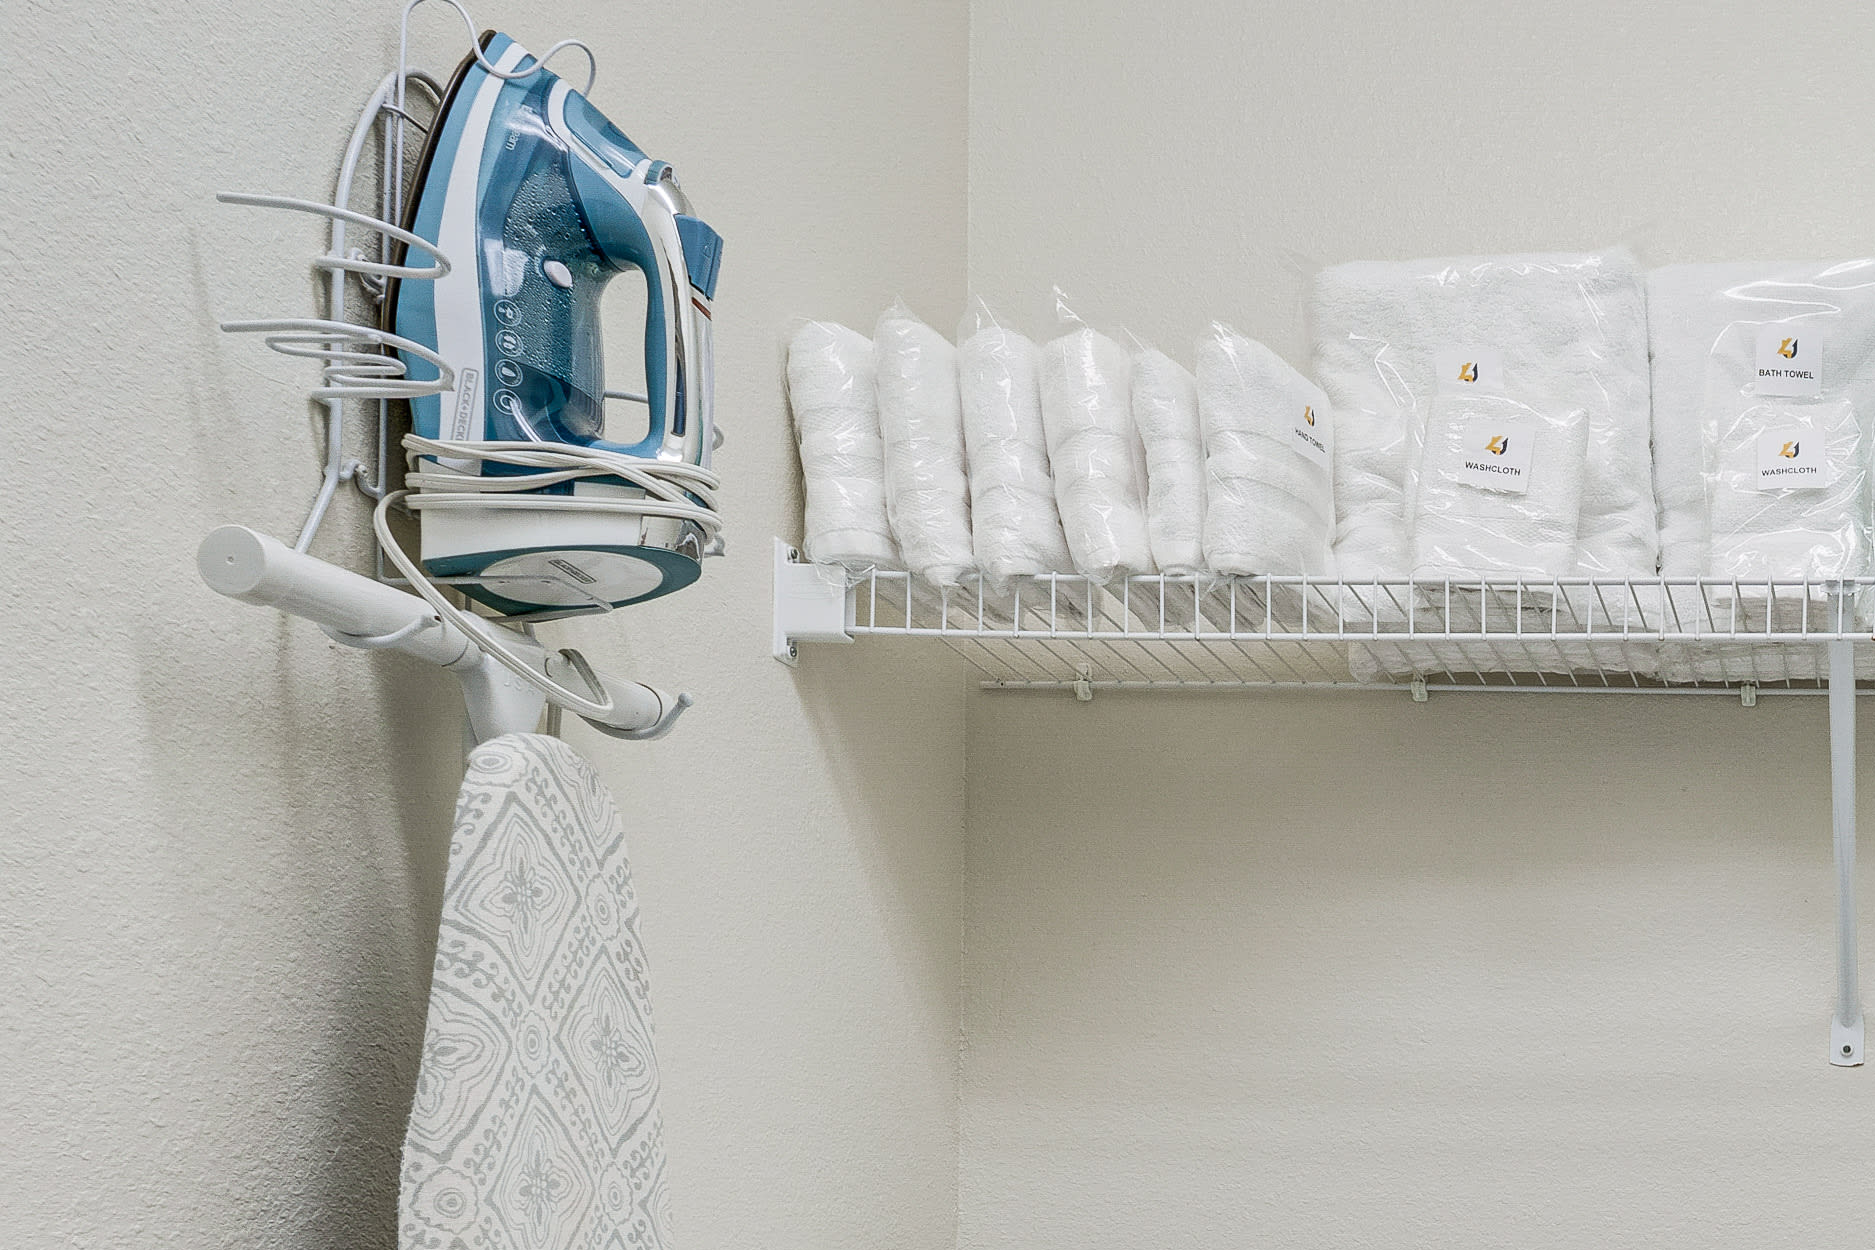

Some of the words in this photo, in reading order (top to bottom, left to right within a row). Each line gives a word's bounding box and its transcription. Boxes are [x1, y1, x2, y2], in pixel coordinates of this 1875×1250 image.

[1759, 369, 1782, 378] BATH
[1785, 370, 1814, 379] TOWEL
[455, 372, 474, 440] BLACK+DECK
[1465, 461, 1521, 476] WASHCLOTH
[1761, 467, 1817, 477] WASHCLOTH
